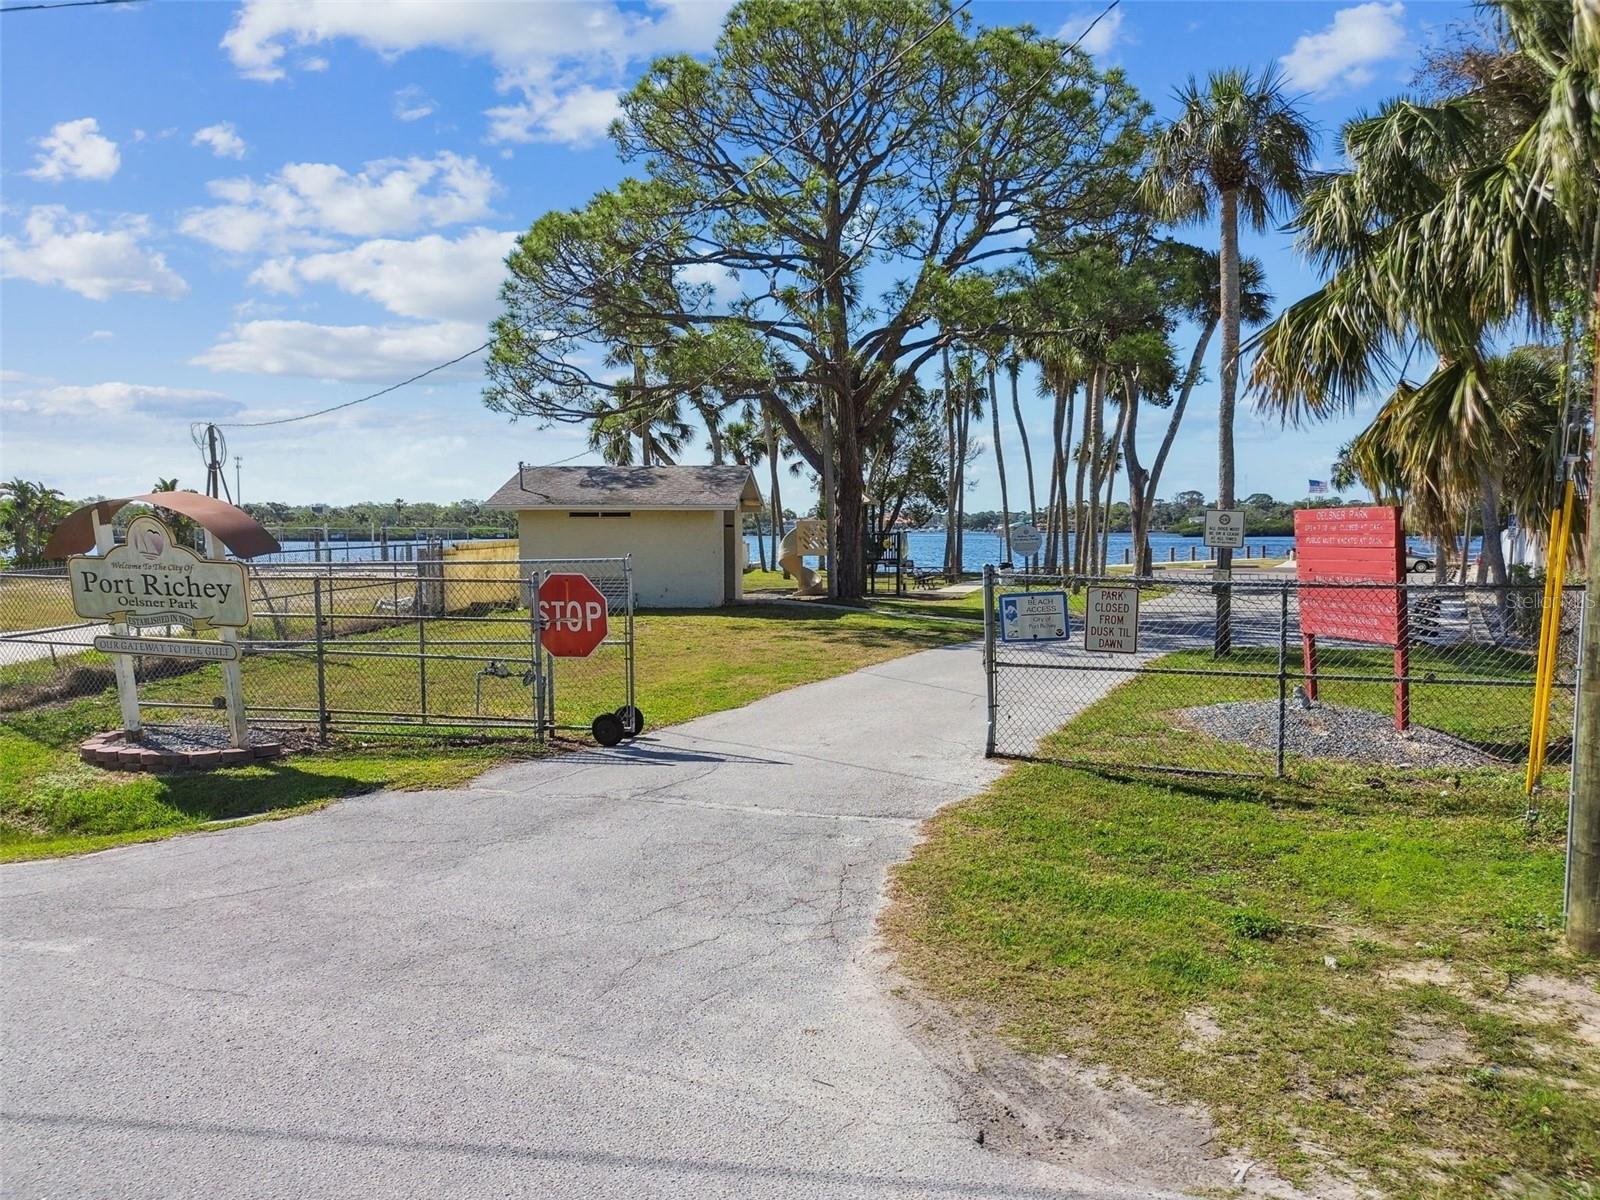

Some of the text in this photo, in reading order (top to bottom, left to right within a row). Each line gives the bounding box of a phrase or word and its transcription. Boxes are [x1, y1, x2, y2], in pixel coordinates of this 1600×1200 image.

[1350, 510, 1368, 519] PARK
[168, 564, 182, 573] City
[184, 564, 194, 573] Of
[81, 571, 232, 604] Port Richey
[1101, 591, 1123, 600] PARK
[118, 596, 198, 610] Oelsner Park
[1095, 603, 1129, 613] CLOSED
[128, 615, 169, 626] ESTABLISHED
[540, 601, 601, 632] STOP
[1100, 615, 1124, 625] FROM
[1091, 627, 1131, 638] DUSK TIL
[100, 641, 120, 649] OUR
[121, 642, 164, 652] GATEWAY
[168, 645, 181, 653] TO
[182, 646, 202, 655] THE
[1098, 639, 1122, 648] DAWN
